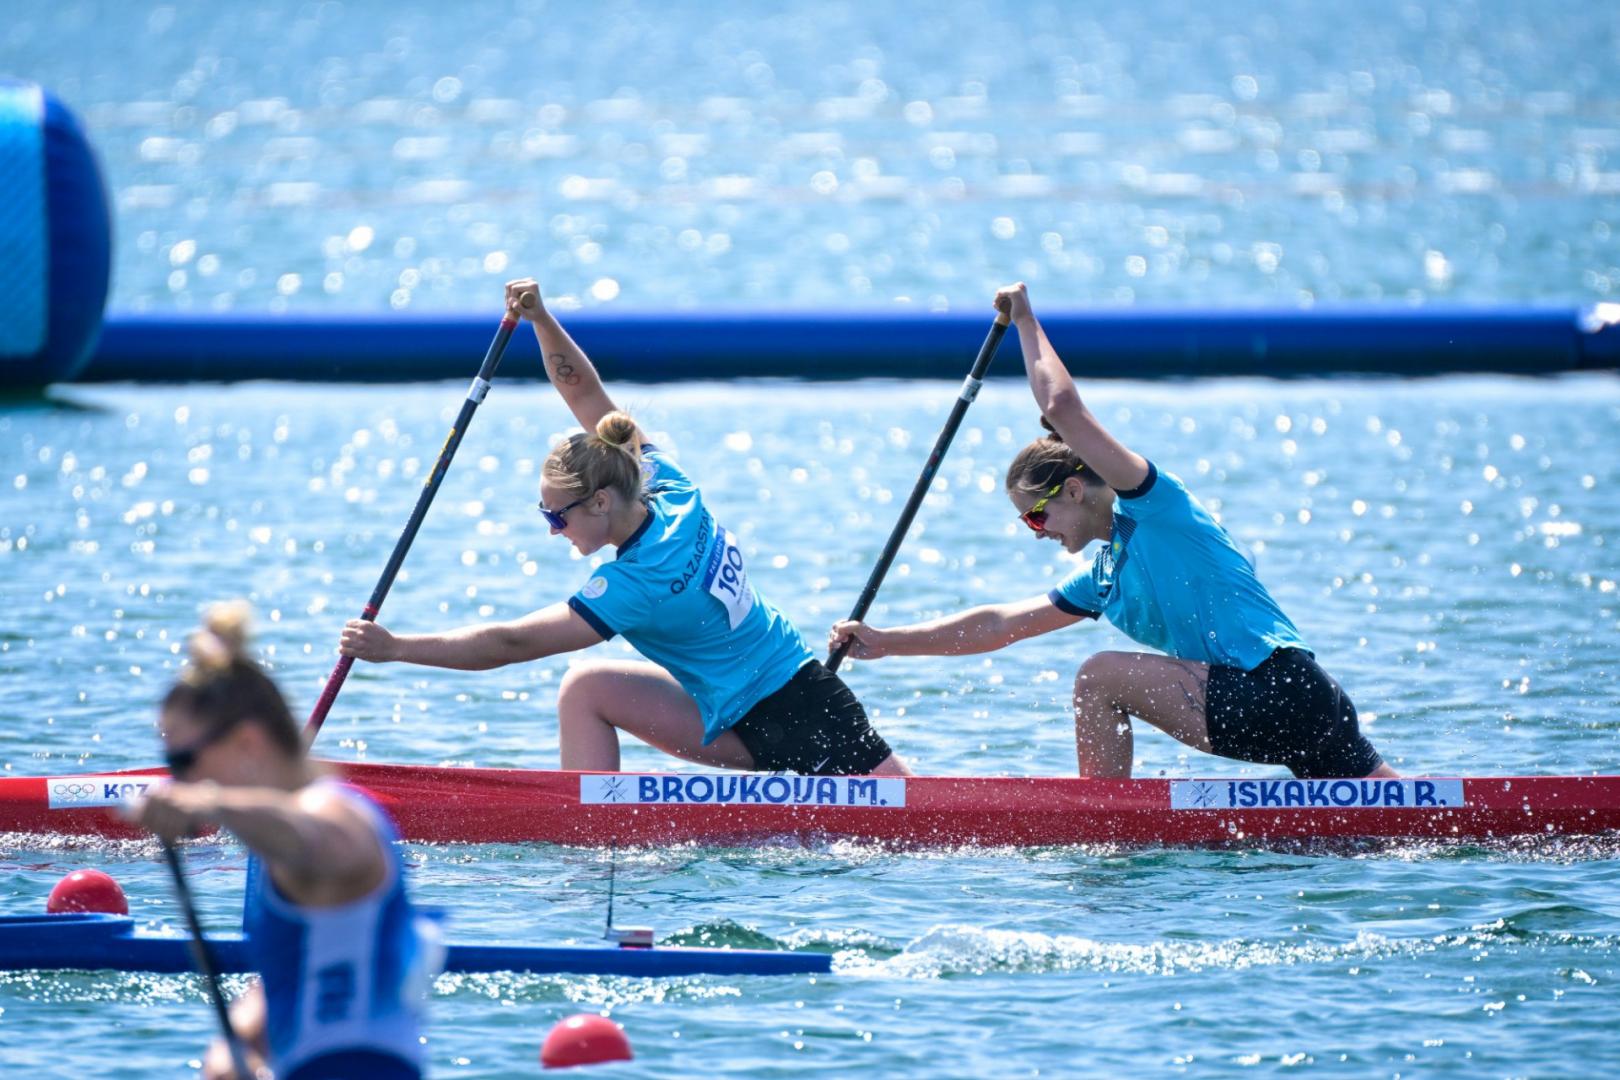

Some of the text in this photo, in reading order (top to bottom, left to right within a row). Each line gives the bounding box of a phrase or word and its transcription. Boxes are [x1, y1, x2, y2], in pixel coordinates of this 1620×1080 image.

[718, 545, 743, 597] 190
[638, 776, 888, 806] BROVKOVA M.
[1229, 780, 1448, 807] ISKAKOVA R.
